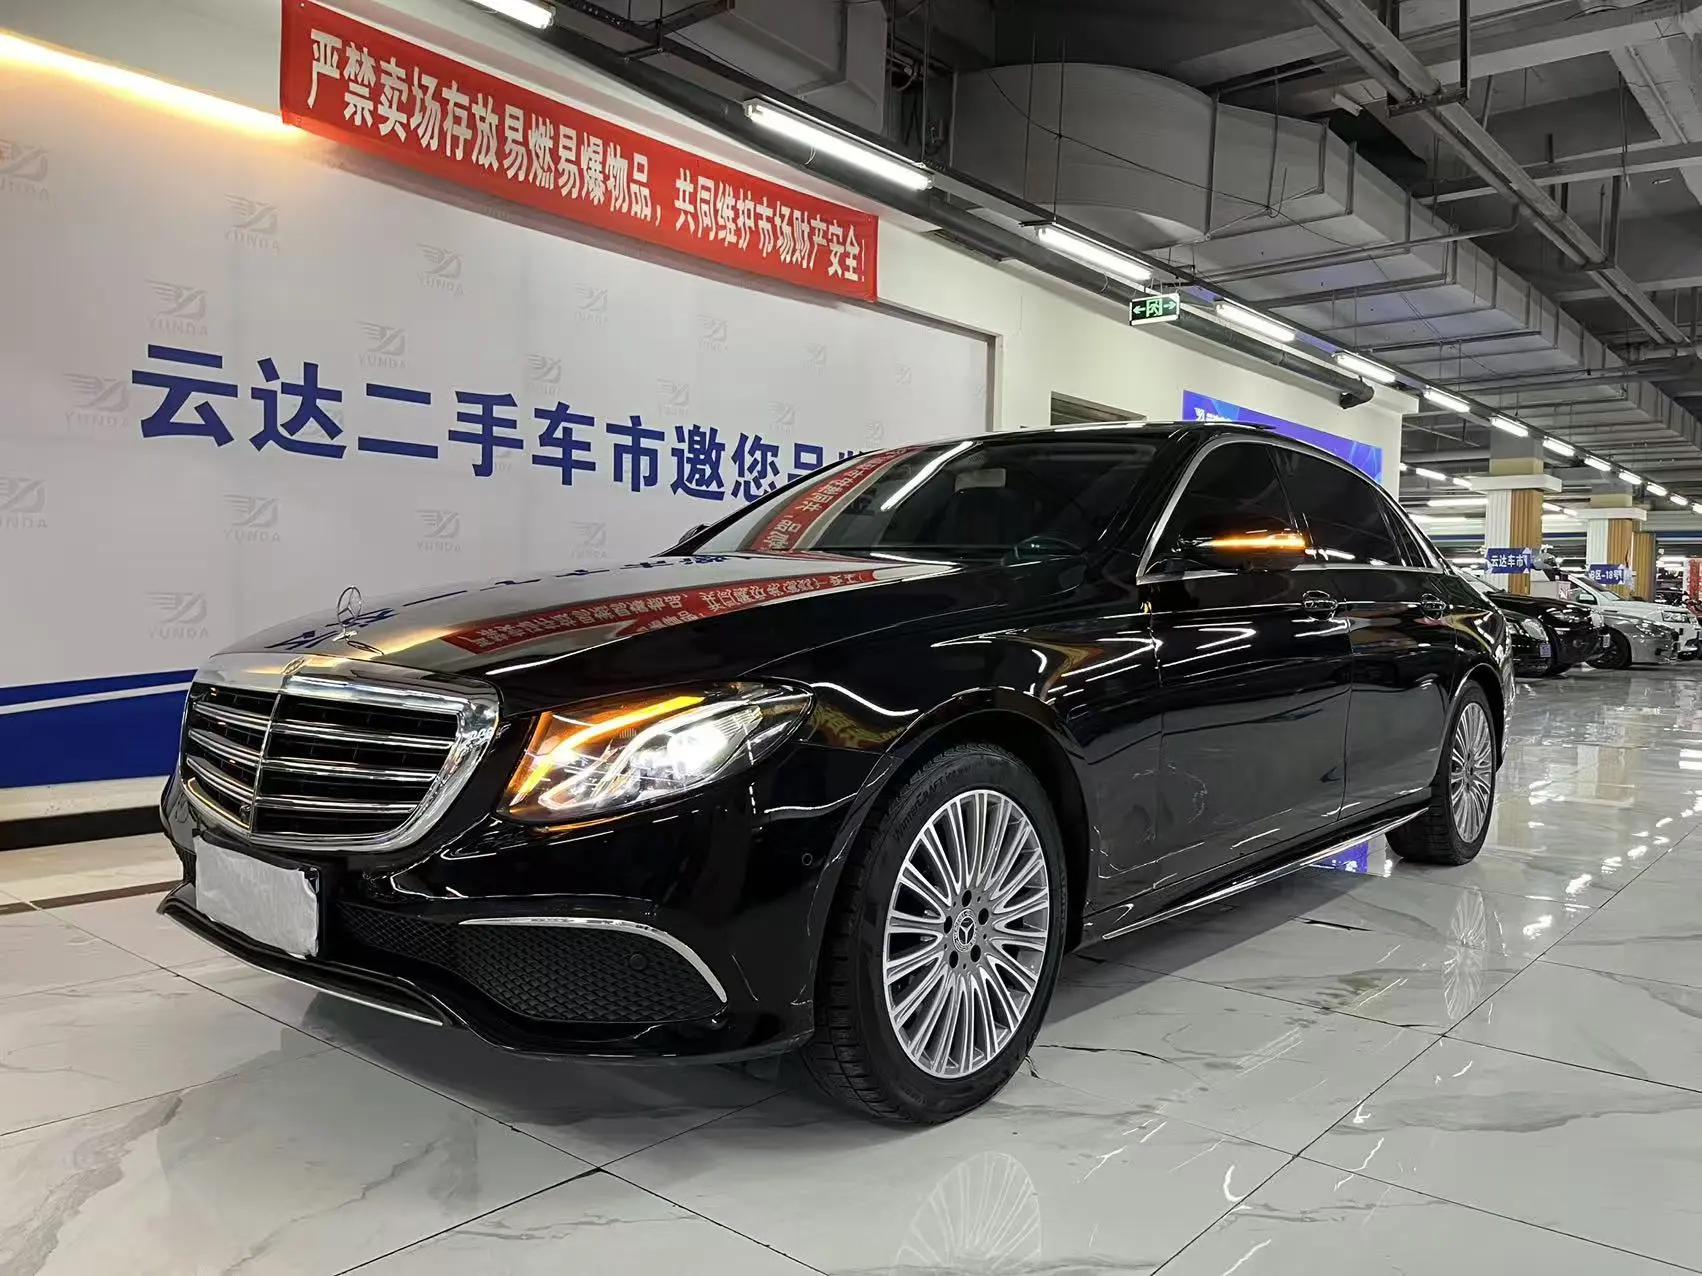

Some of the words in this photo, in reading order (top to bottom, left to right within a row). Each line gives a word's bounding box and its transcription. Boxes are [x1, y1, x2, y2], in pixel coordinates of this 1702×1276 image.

[132, 344, 866, 501] 云达二手车市邀您品
[223, 529, 281, 543] YUNDA
[147, 626, 210, 640] YUNDA
